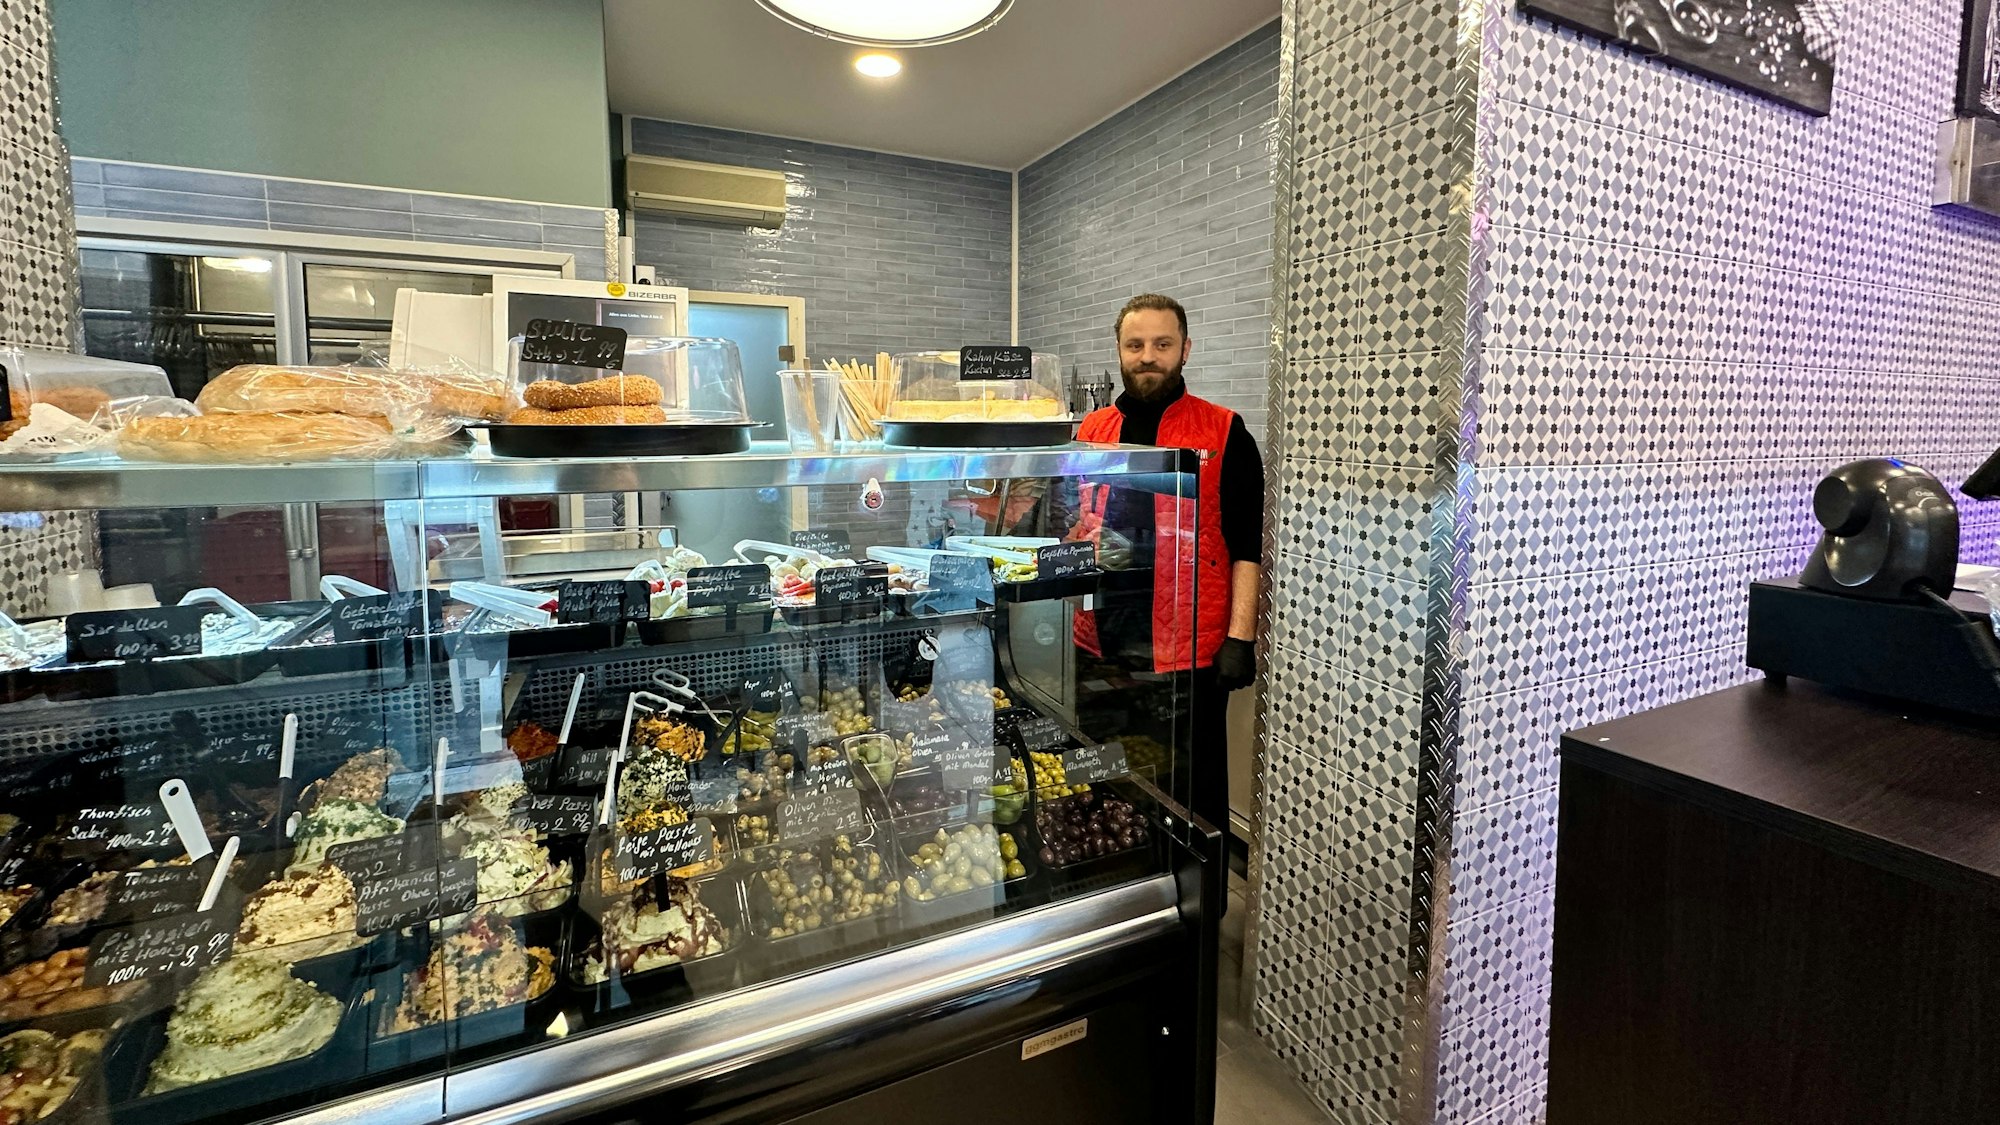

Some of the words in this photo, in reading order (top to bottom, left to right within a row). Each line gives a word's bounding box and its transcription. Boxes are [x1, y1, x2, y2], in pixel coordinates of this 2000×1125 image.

[628, 291, 677, 300] BIZERBA
[348, 613, 402, 630] Tomaten
[79, 804, 152, 820] Thunfisch
[698, 849, 708, 861] €
